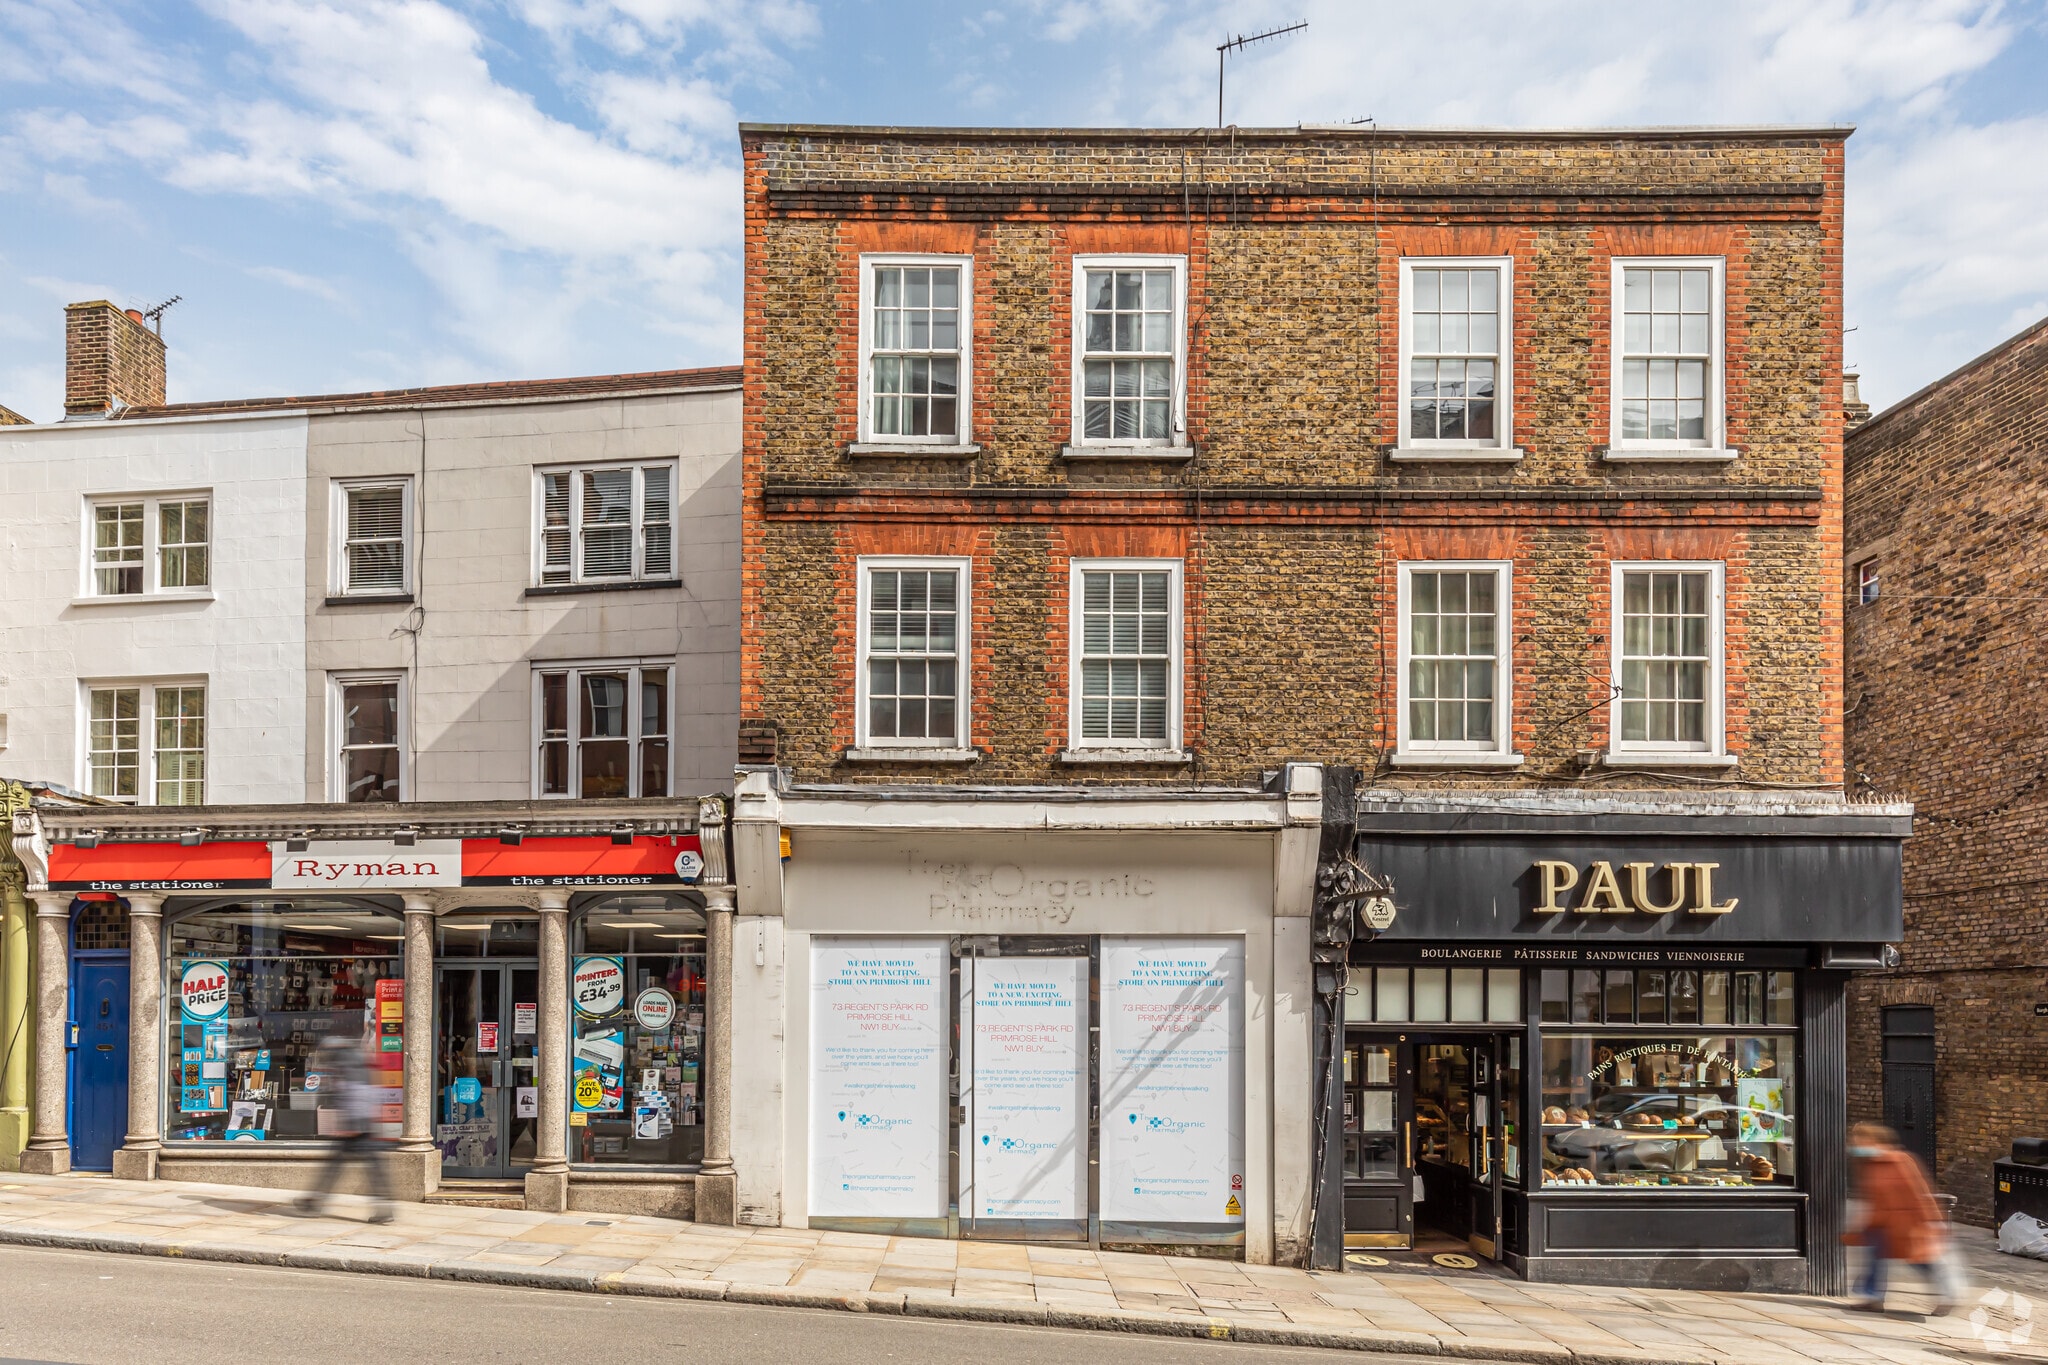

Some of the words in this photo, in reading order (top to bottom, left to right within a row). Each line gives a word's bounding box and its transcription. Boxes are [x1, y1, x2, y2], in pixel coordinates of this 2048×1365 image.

[293, 860, 439, 880] Ryman
[90, 881, 123, 889] the
[129, 880, 224, 889] stationer
[510, 877, 545, 885] the
[553, 875, 652, 885] stationer
[989, 863, 1153, 904] Organic
[1533, 861, 1739, 913] PAUL
[930, 894, 1075, 924] Pharmacy
[1421, 949, 1502, 958] BOULANGERIE
[1514, 948, 1578, 959] PÂTISSERIE
[1586, 951, 1660, 960] SANDWICHES
[1666, 952, 1745, 961] VIENNOISERIE
[576, 968, 618, 983] PRINTERS
[183, 975, 227, 996] HALF
[587, 979, 606, 987] FROM
[579, 983, 620, 1003] £34.99
[642, 1005, 668, 1013] ONLINE
[1122, 1004, 1134, 1012] 73
[1135, 1004, 1180, 1012] REGENT'S
[1182, 1004, 1206, 1012] PARK
[1208, 1004, 1222, 1012] RD
[1587, 1060, 1613, 1080] PAINS
[1614, 1043, 1666, 1063] RUSTIQUES
[1671, 1044, 1683, 1052] ET
[1687, 1046, 1700, 1056] DE
[578, 1086, 600, 1096] 20%
[870, 1114, 912, 1126] Organic
[1162, 1117, 1206, 1128] Organic
[854, 1122, 893, 1131] Pharmacy
[1146, 1125, 1185, 1134] Pharmacy
[1015, 1138, 1057, 1150] Organic
[999, 1146, 1038, 1156] Pharmacy
